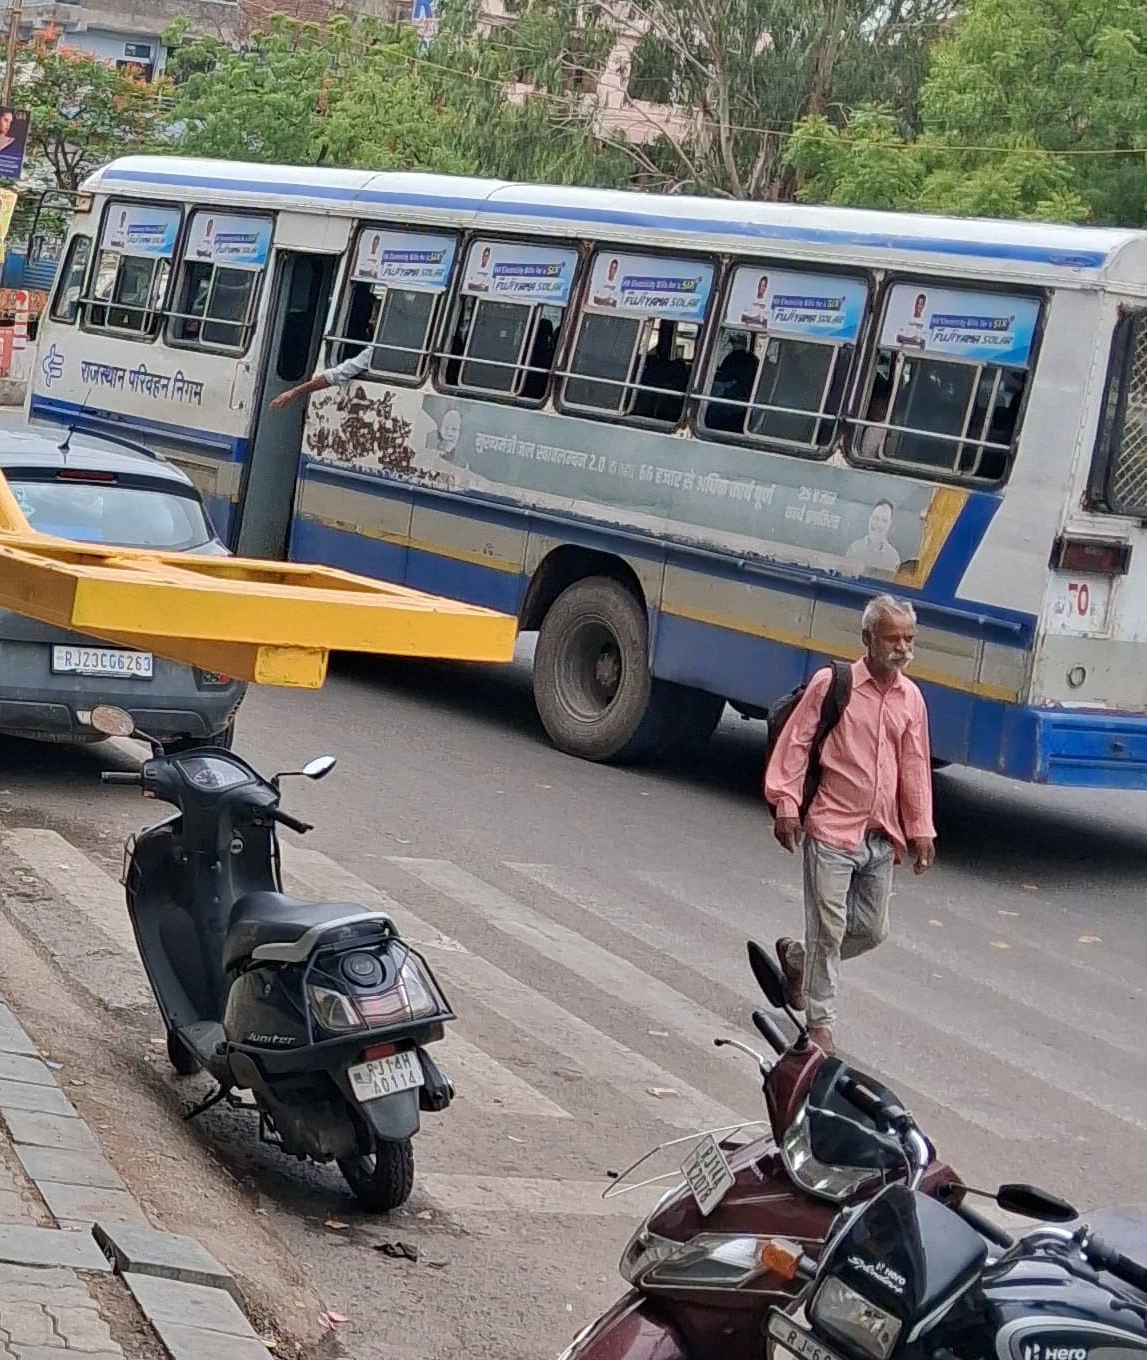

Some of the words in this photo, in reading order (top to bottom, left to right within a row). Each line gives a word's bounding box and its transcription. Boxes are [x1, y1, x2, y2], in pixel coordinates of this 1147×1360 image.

[496, 282, 536, 292] FUJIYAMA
[536, 282, 564, 292] SOLAR
[682, 281, 695, 290] SIX
[624, 296, 669, 307] FUJIYAMA
[670, 297, 700, 307] SOLAR
[993, 319, 1008, 329] SIX
[934, 332, 981, 344] FUJIYAMA
[981, 334, 1012, 344] SOLAR
[81, 360, 127, 390] राजस्थान
[129, 363, 172, 399] परिवहन
[172, 370, 205, 406] निगम
[517, 441, 535, 459] जल
[588, 454, 605, 473] 2.0
[639, 464, 653, 481] 66
[656, 468, 682, 488] हजार
[247, 1032, 296, 1045] Jupiter
[1045, 1347, 1087, 1360] Hero
